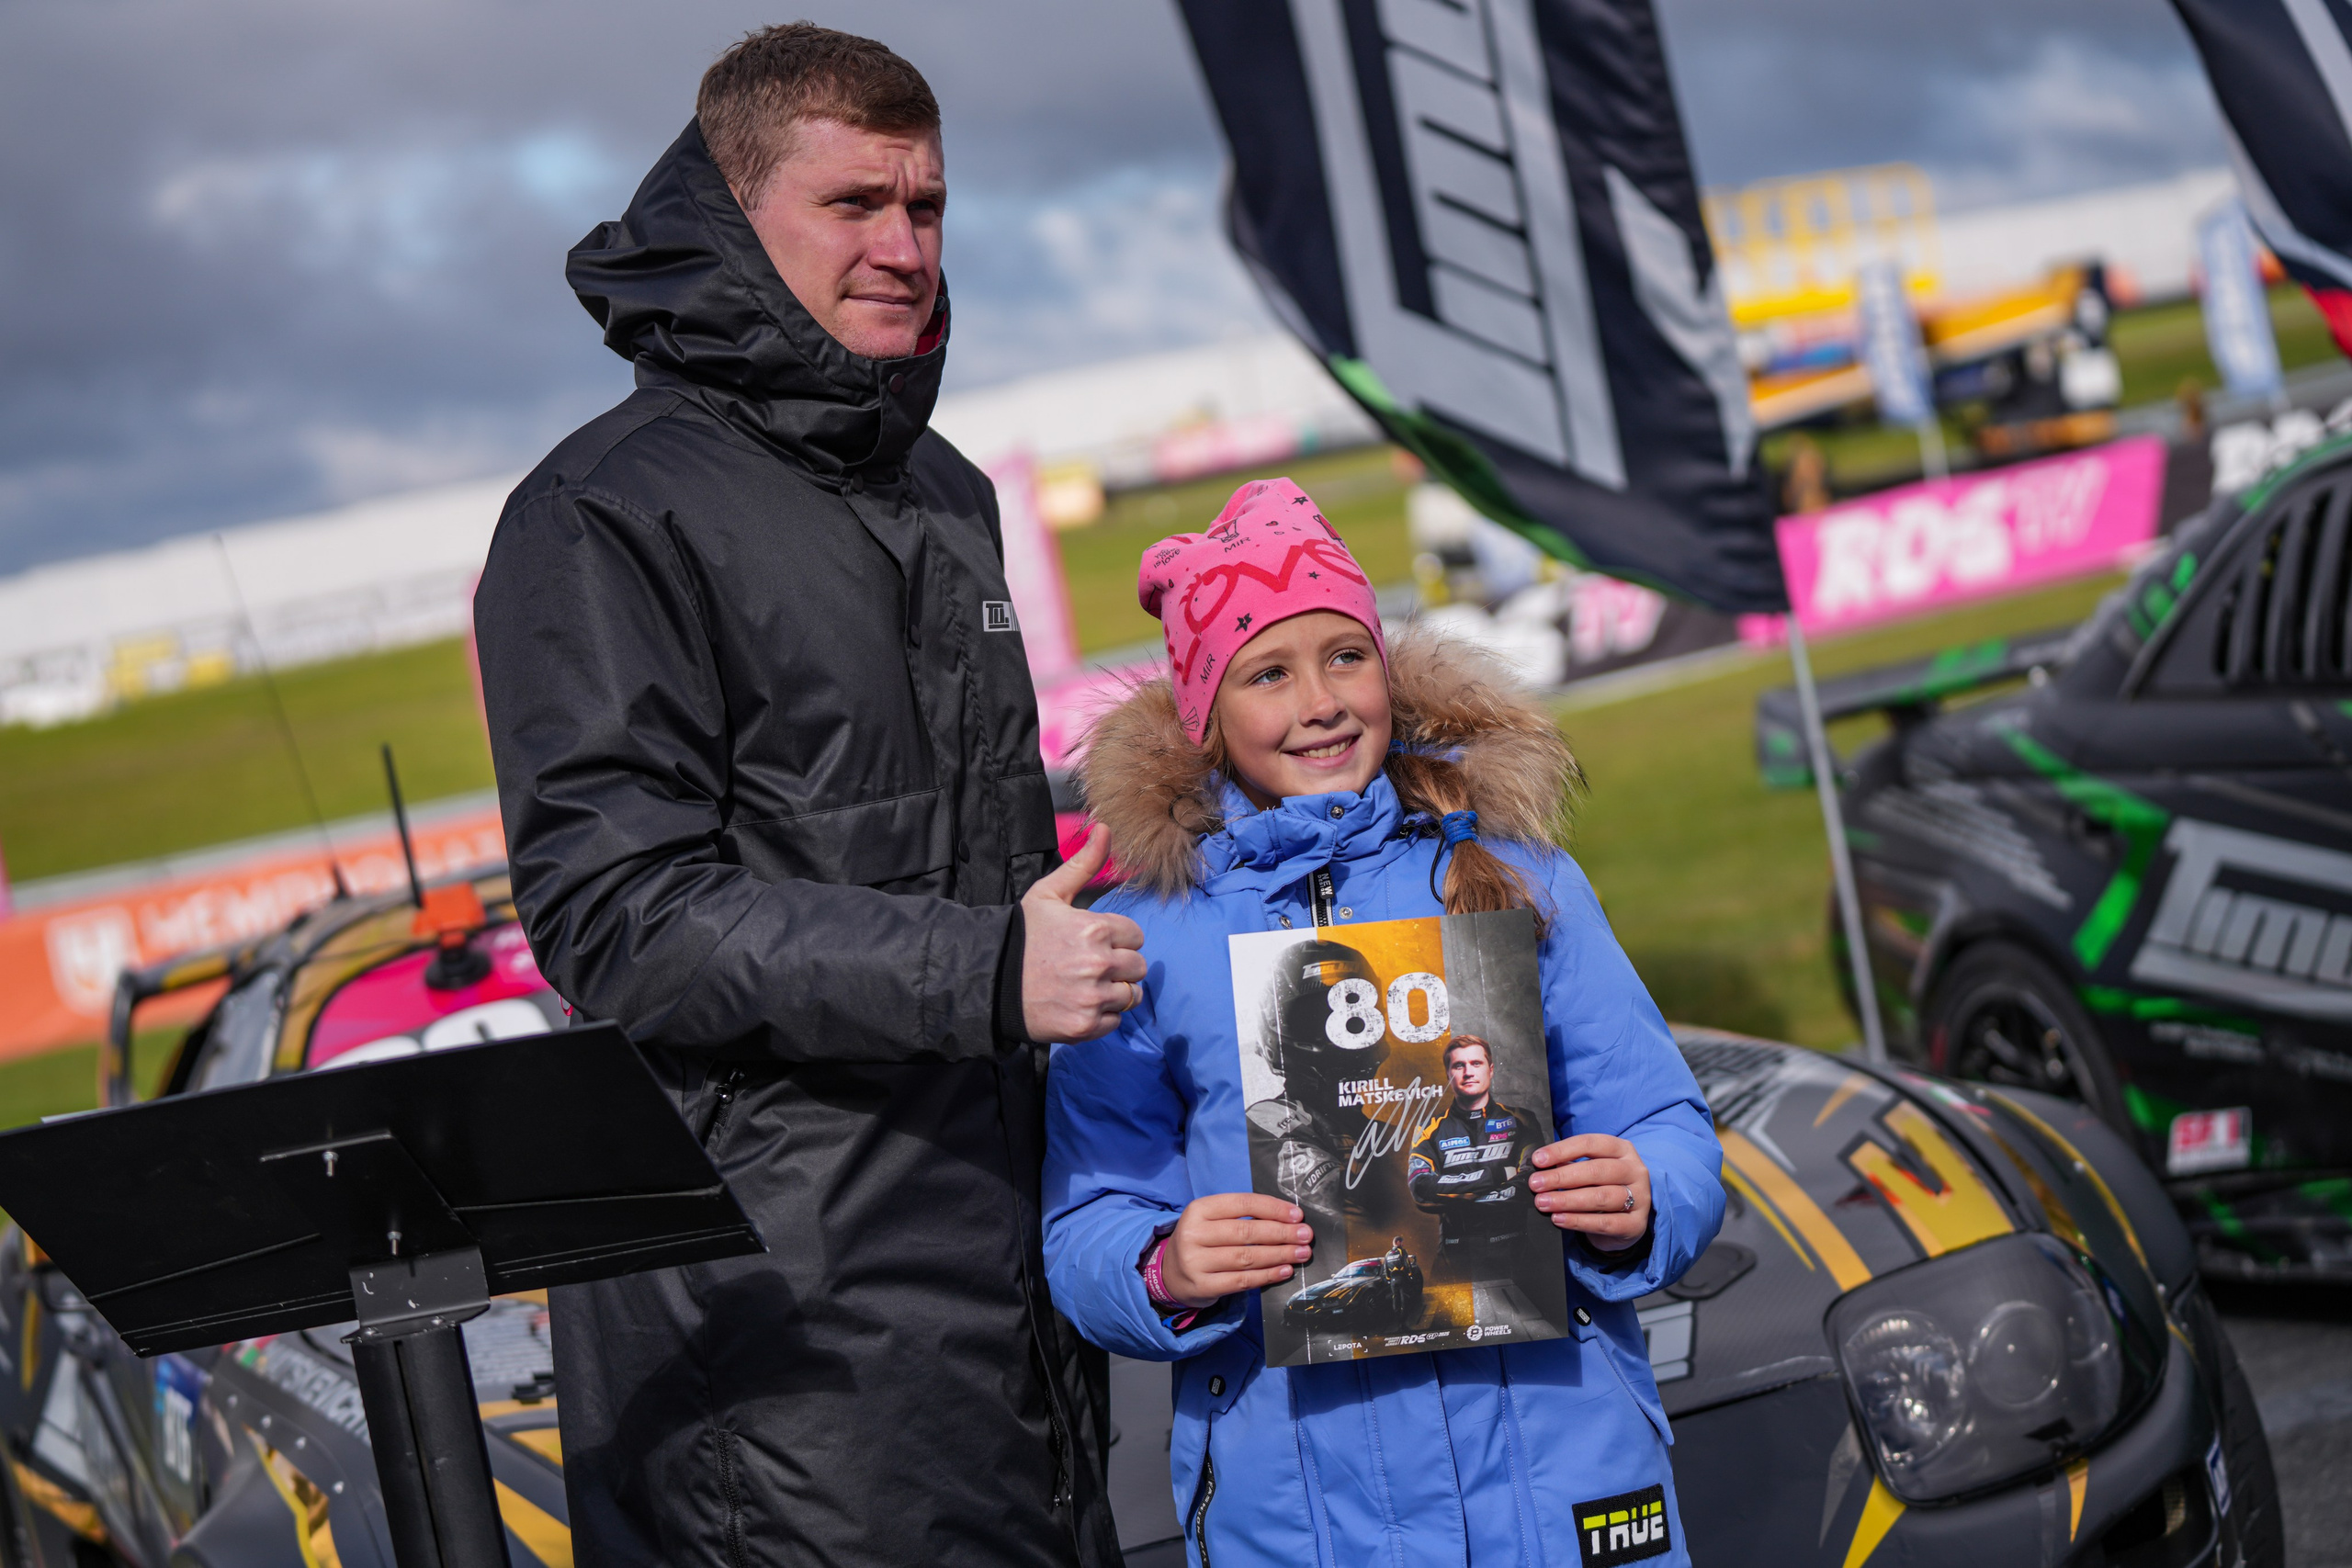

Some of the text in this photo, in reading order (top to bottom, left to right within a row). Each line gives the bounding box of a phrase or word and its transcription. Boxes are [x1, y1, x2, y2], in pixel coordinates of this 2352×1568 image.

[1322, 873, 1333, 895] NEW
[1325, 972, 1451, 1050] 80
[1339, 1077, 1394, 1094] KIRILL
[1339, 1085, 1443, 1107] MATSKEVICH
[1400, 1334, 1428, 1345] RDS
[1484, 1328, 1512, 1337] WHEELS
[1333, 1342, 1363, 1351] LEPOTA
[1583, 1500, 1664, 1555] TRUE
